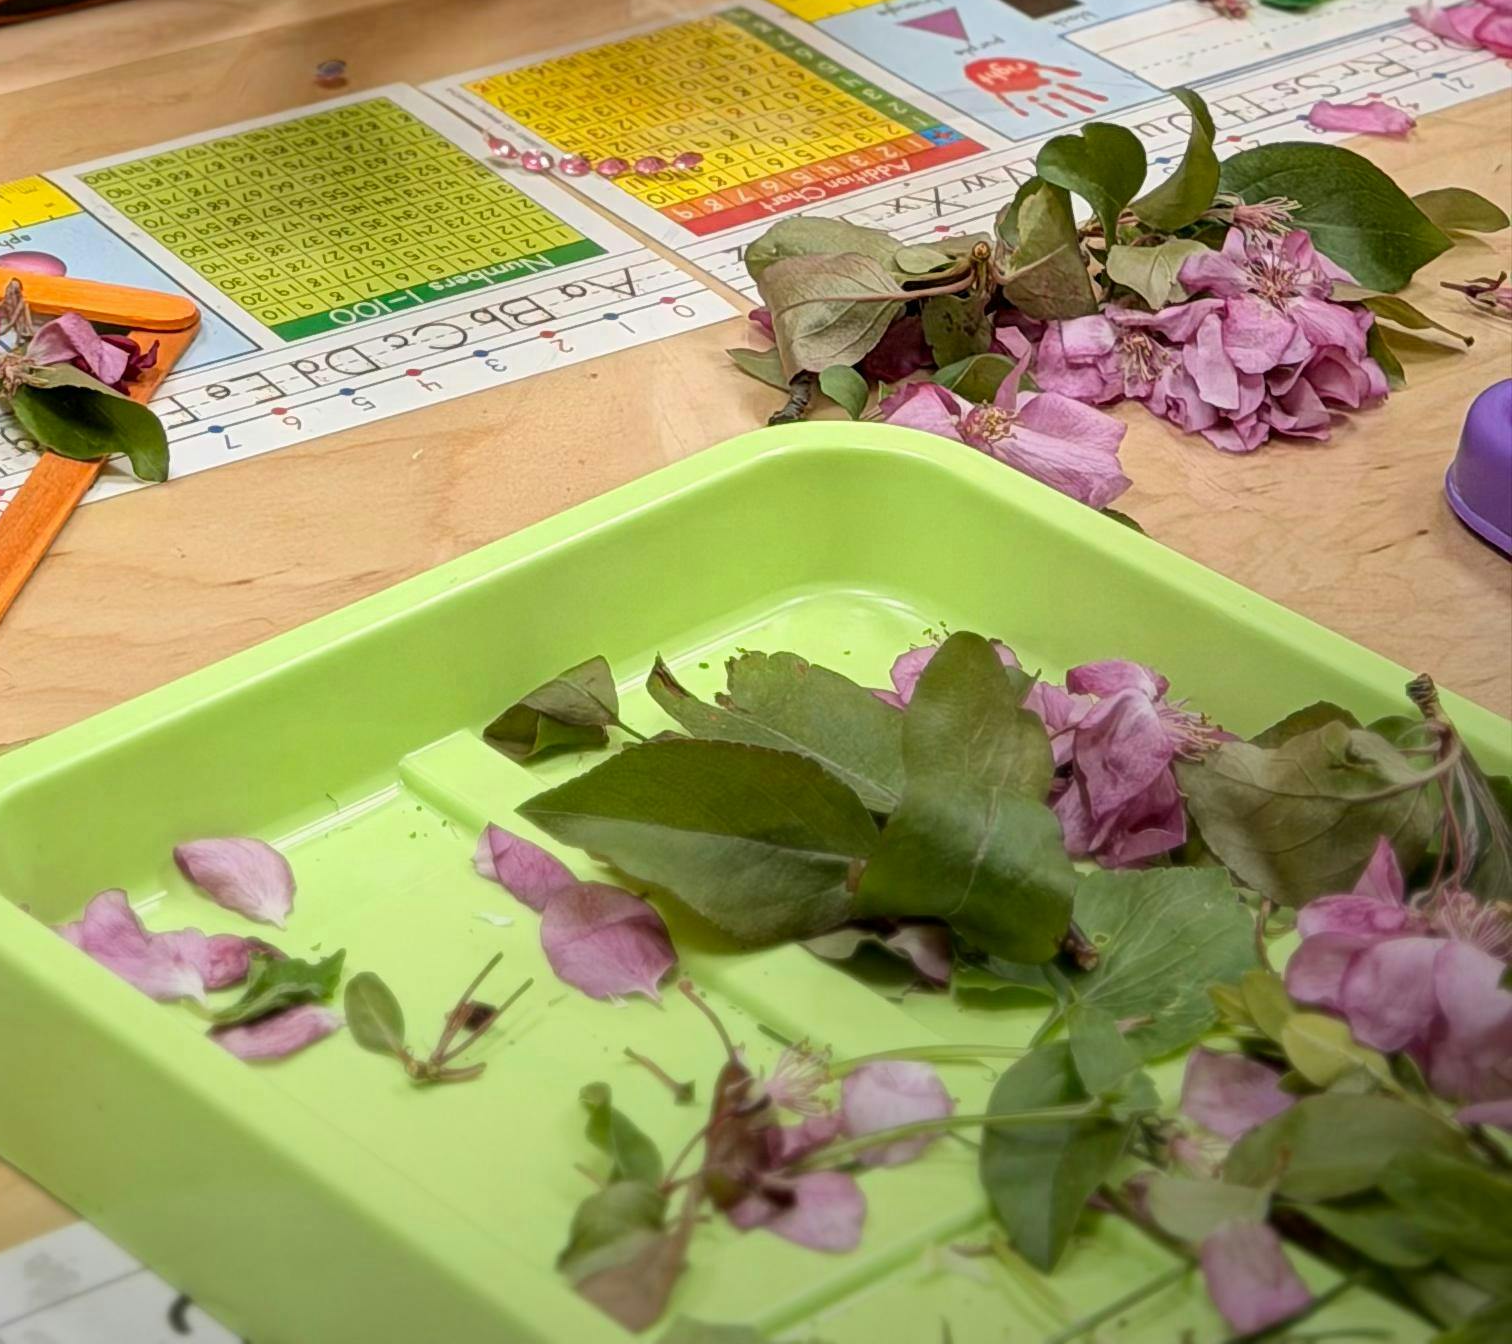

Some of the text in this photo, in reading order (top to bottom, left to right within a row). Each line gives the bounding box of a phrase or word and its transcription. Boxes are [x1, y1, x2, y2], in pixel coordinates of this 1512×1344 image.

[975, 60, 1029, 87] right
[854, 133, 872, 143] 3
[794, 150, 816, 160] 5
[823, 143, 845, 152] 4
[767, 158, 784, 168] 6
[672, 139, 924, 218] 1 2 3 4 5 6 7 8 9
[742, 166, 758, 178] 7
[708, 176, 727, 187] 8
[759, 158, 912, 213] Addition Chart
[647, 192, 674, 204] 10
[677, 186, 698, 195] 9
[162, 156, 474, 243] 51 52 53 54 55 56 57 58 59 60
[180, 170, 492, 258] 41 42 43 44 45 46 47 48 49 50
[200, 185, 513, 274] 31 32 33 34 35 36 37 38 39 40
[220, 199, 534, 289] 21 22 23 24 25 26 27 28 29 30
[240, 215, 554, 305] 11 12 13 14 15 16 17 18 19 20
[262, 230, 568, 320] 1 2 3 4 5 6 7 8 9 10
[329, 252, 558, 326] Numbers 1-100
[550, 338, 574, 354] 2
[484, 358, 508, 373] 3
[415, 377, 443, 393] 4
[351, 396, 377, 412] 5
[281, 415, 303, 431] 6
[224, 433, 243, 450] 7
